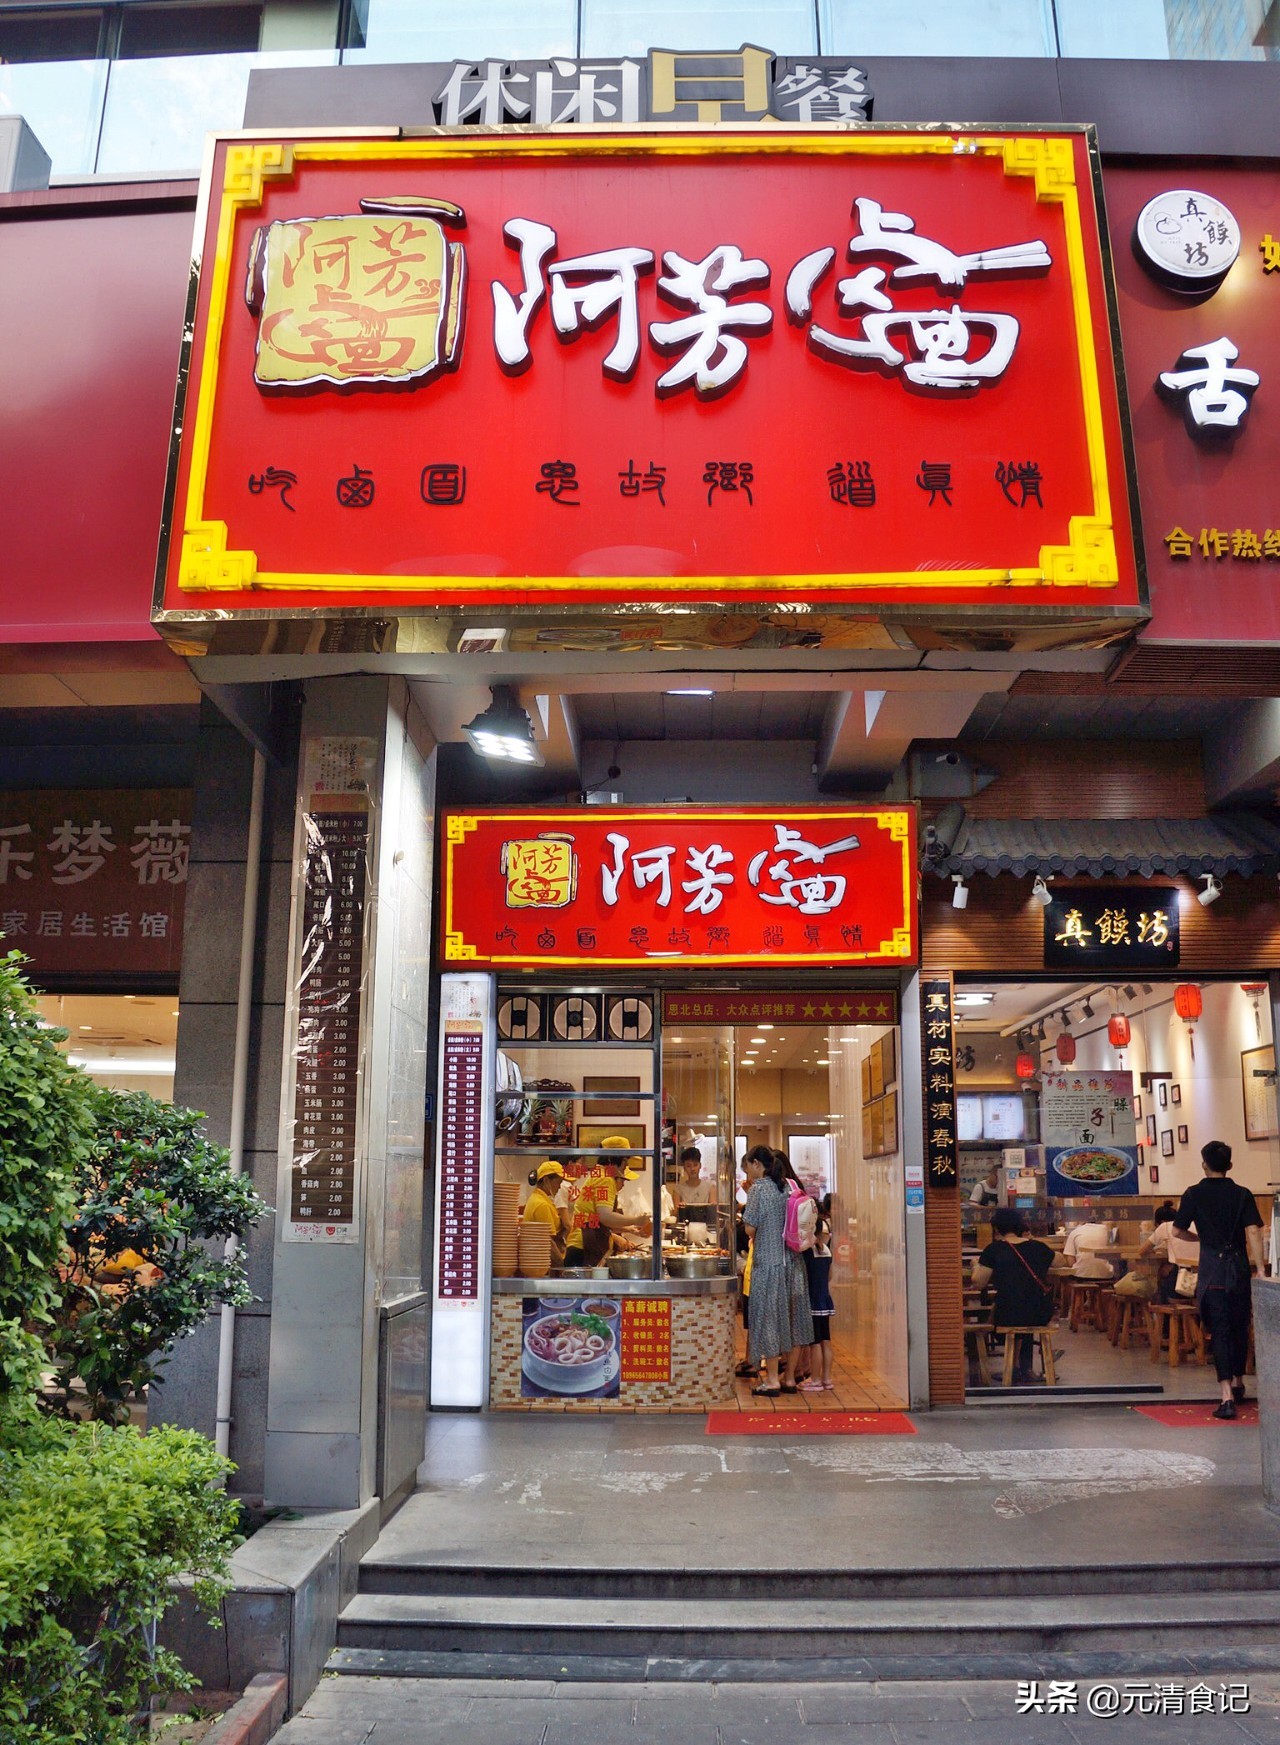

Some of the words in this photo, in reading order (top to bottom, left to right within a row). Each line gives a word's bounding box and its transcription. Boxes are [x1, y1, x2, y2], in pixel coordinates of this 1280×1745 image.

[438, 45, 872, 122] 休闲早餐
[1160, 336, 1260, 427] 舌
[1, 909, 169, 938] 家居生活馆
[305, 1072, 317, 1080] 五香
[926, 993, 955, 1175] 真材实料演春秋
[304, 1099, 322, 1107] 玉米肠
[304, 1113, 322, 1121] 黄花菜
[568, 1185, 609, 1202] 沙茶面
[328, 1208, 341, 1216] 2.00
[625, 1300, 668, 1313] 高薪诚聘
